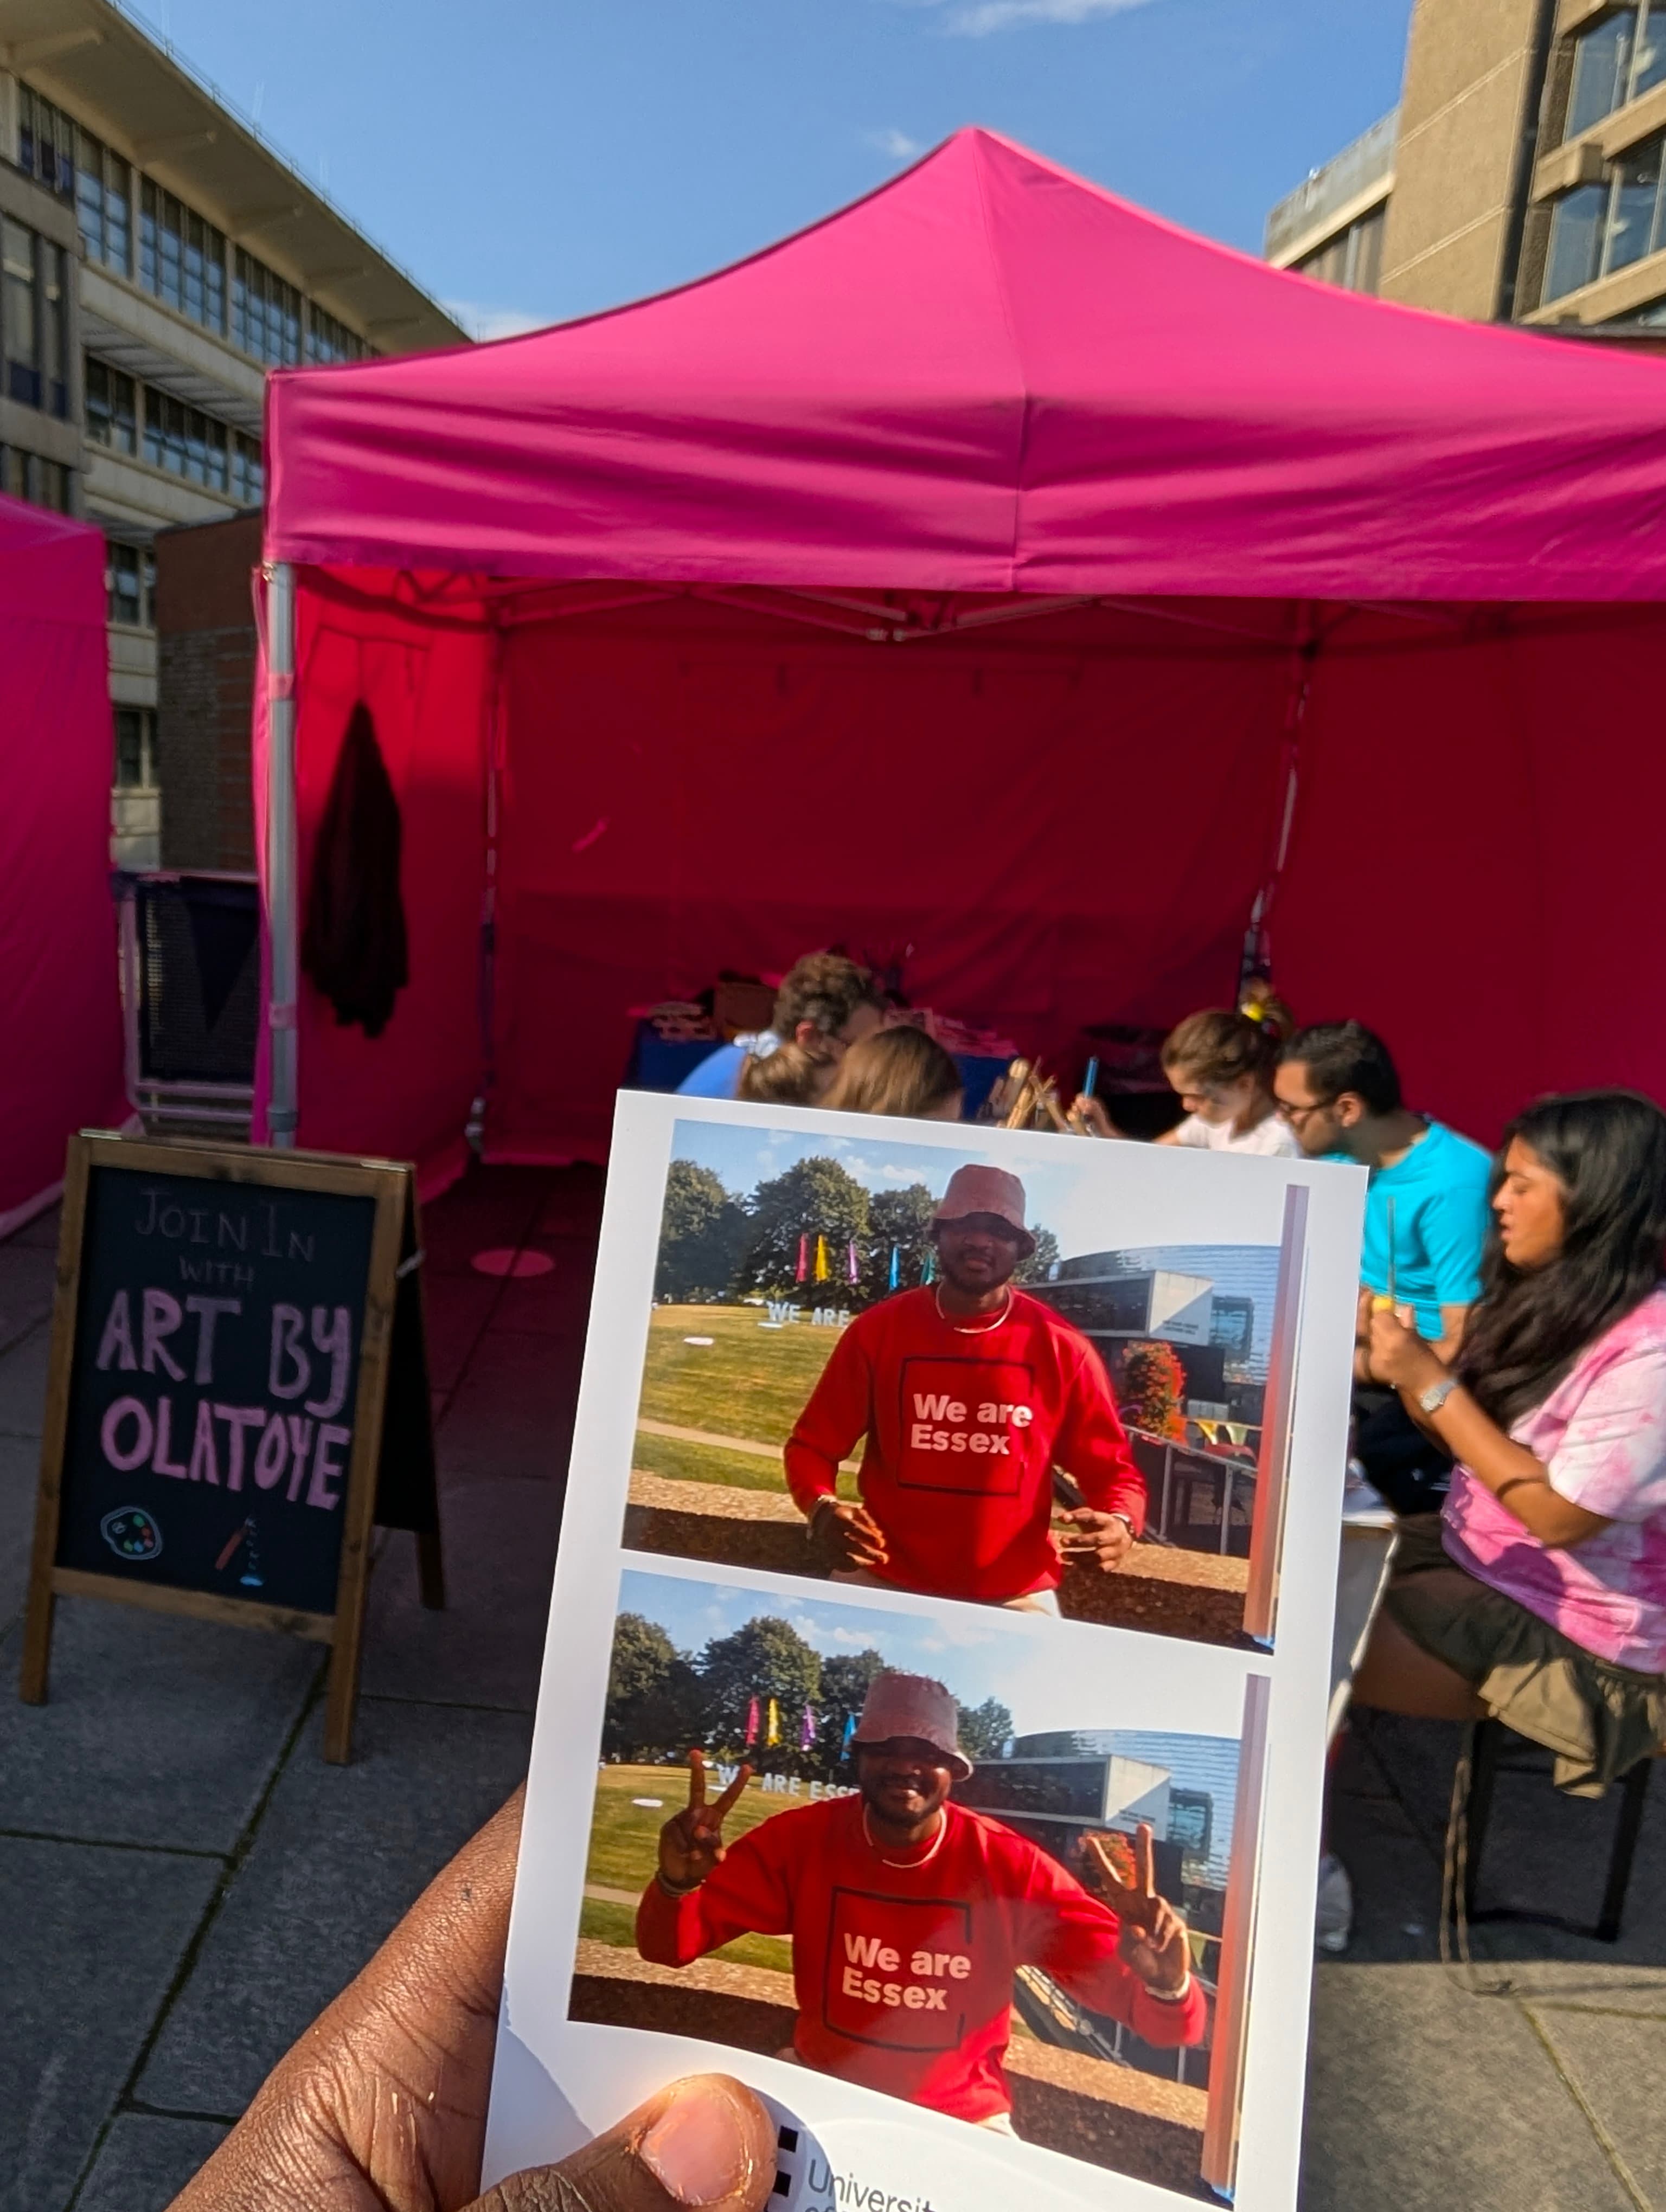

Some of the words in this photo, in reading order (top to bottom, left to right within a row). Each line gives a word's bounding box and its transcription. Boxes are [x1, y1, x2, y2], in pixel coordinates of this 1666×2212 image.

[133, 1188, 247, 1251] JOIN
[260, 1200, 315, 1263] IN
[178, 1255, 255, 1291] WITH
[766, 1301, 801, 1324] WE
[811, 1307, 850, 1328] ARE
[96, 1288, 242, 1385] ART
[268, 1304, 351, 1418] BY
[913, 1393, 967, 1423] We
[976, 1401, 1033, 1427] are
[101, 1396, 350, 1510] OLATOYE
[911, 1423, 1010, 1455] Essex
[761, 1772, 802, 1797] ARE
[843, 1933, 901, 1972] We
[910, 1950, 971, 1979] are
[842, 1966, 948, 2011] Essex
